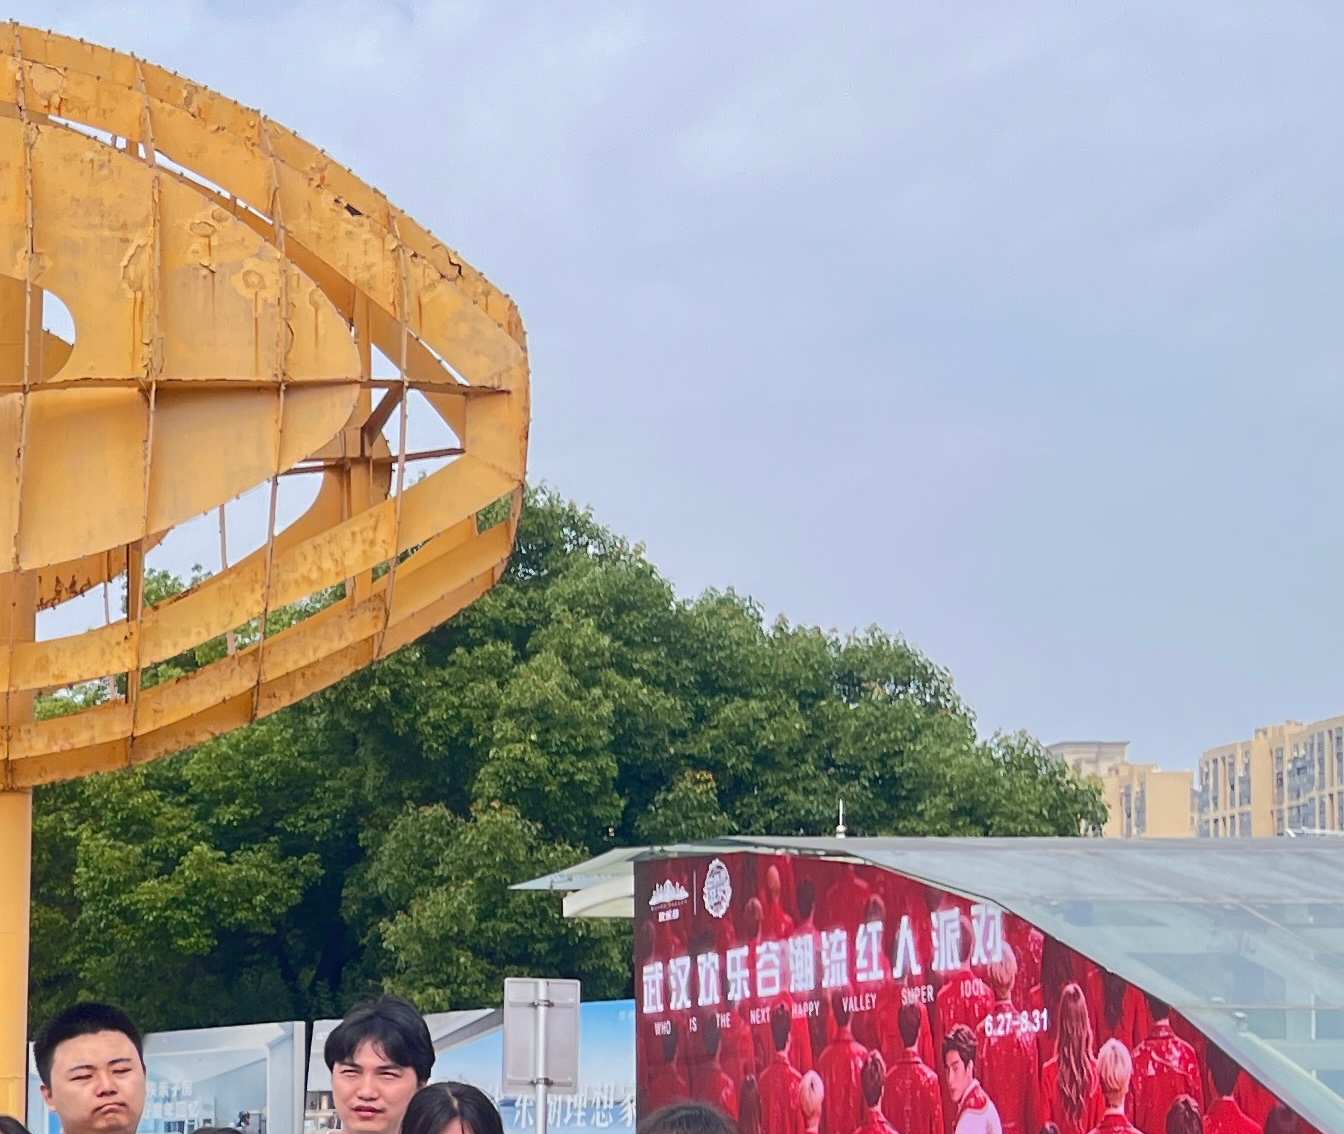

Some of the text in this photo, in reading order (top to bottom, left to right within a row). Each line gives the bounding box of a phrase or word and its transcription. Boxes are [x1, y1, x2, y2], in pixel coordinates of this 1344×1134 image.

[642, 903, 1004, 1015] 武汉欢乐谷潮流红人派对
[654, 1021, 672, 1036] WHO
[689, 1016, 698, 1033] IS
[715, 1012, 731, 1029] THE
[750, 1006, 770, 1025] NEXT
[791, 1000, 820, 1020] HAPPY
[842, 993, 877, 1014] VALLEY
[984, 1007, 1049, 1038] 6.27-8.31
